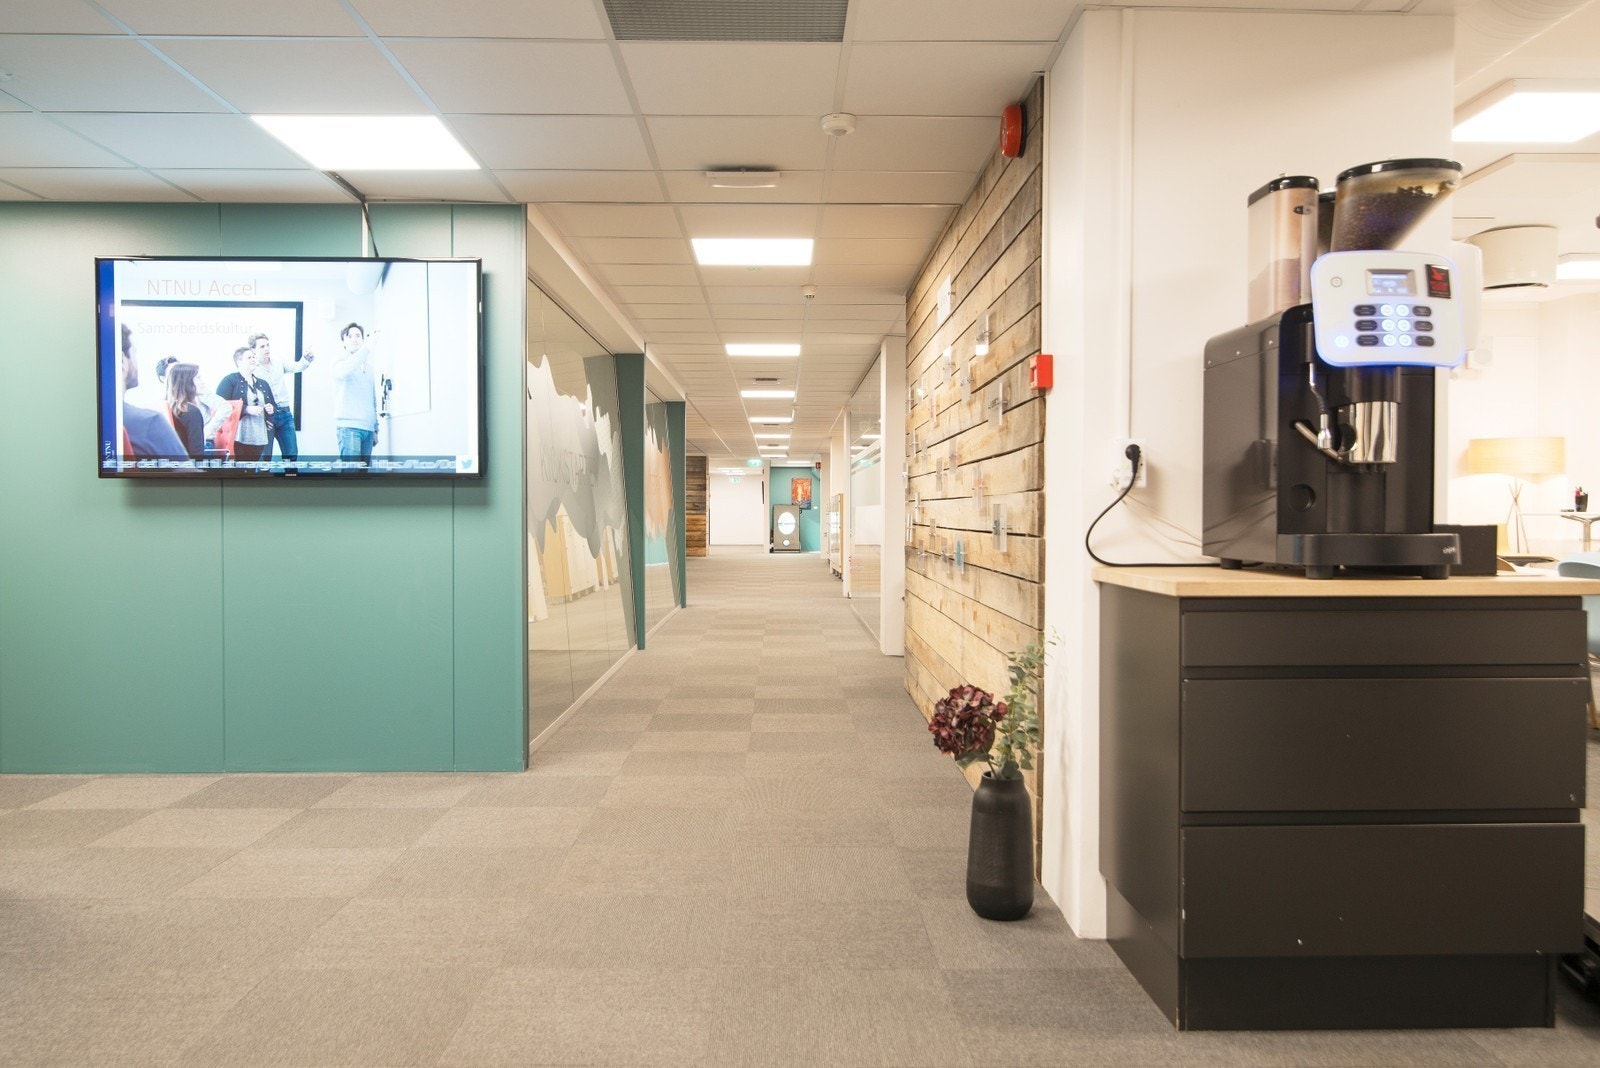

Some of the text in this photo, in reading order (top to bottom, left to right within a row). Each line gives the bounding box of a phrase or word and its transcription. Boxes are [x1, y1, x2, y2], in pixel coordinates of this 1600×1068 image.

[147, 279, 257, 296] NTNU Accel
[137, 321, 255, 335] Samarbeidskultur
